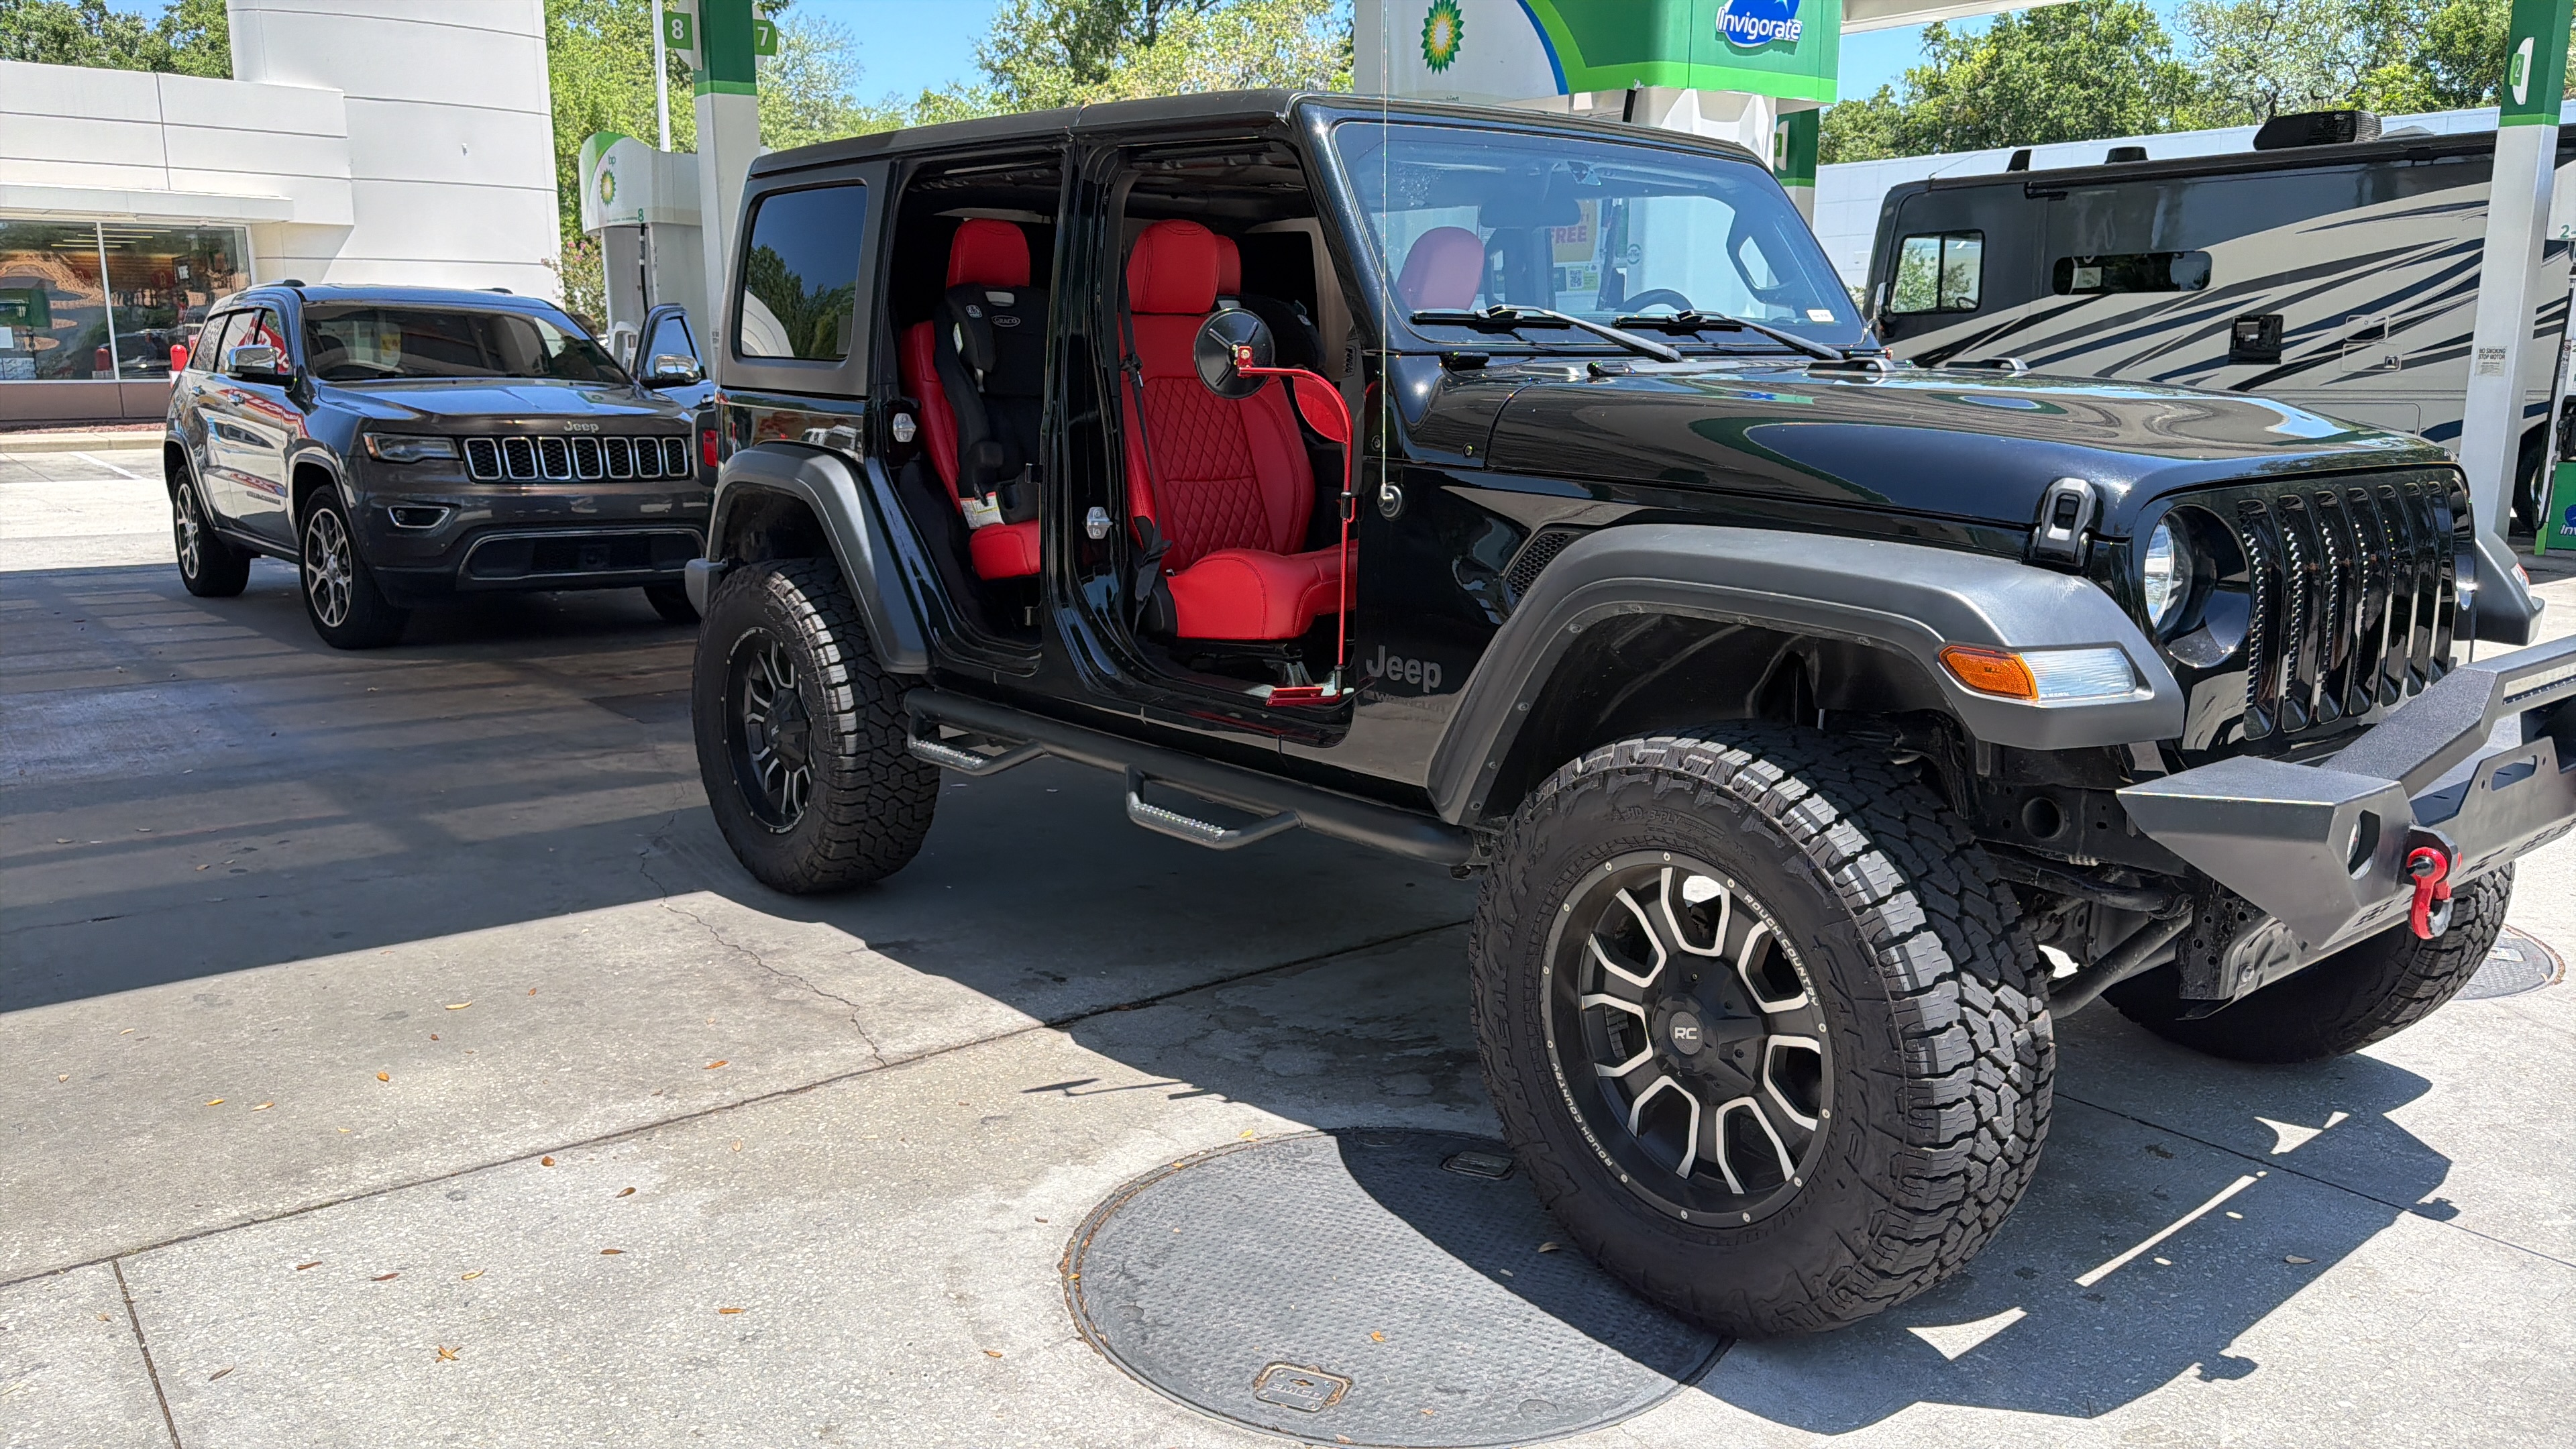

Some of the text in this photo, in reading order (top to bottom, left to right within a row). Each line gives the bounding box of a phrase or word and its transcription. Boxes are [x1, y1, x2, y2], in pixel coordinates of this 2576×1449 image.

[672, 19, 684, 40] 8
[1718, 7, 1802, 40] Invigorate
[757, 26, 769, 46] 7
[2514, 59, 2521, 78] 2
[608, 154, 616, 166] bp
[638, 208, 644, 222] 8
[2560, 224, 2570, 238] 2
[564, 420, 600, 434] Jeep
[1365, 645, 1442, 694] Jeep
[1743, 894, 1783, 936] ROUGH
[1780, 938, 1819, 1007] COUNTRY
[1674, 1026, 1697, 1040] RC
[1551, 1062, 1614, 1167] ROUGH COUNTRY
